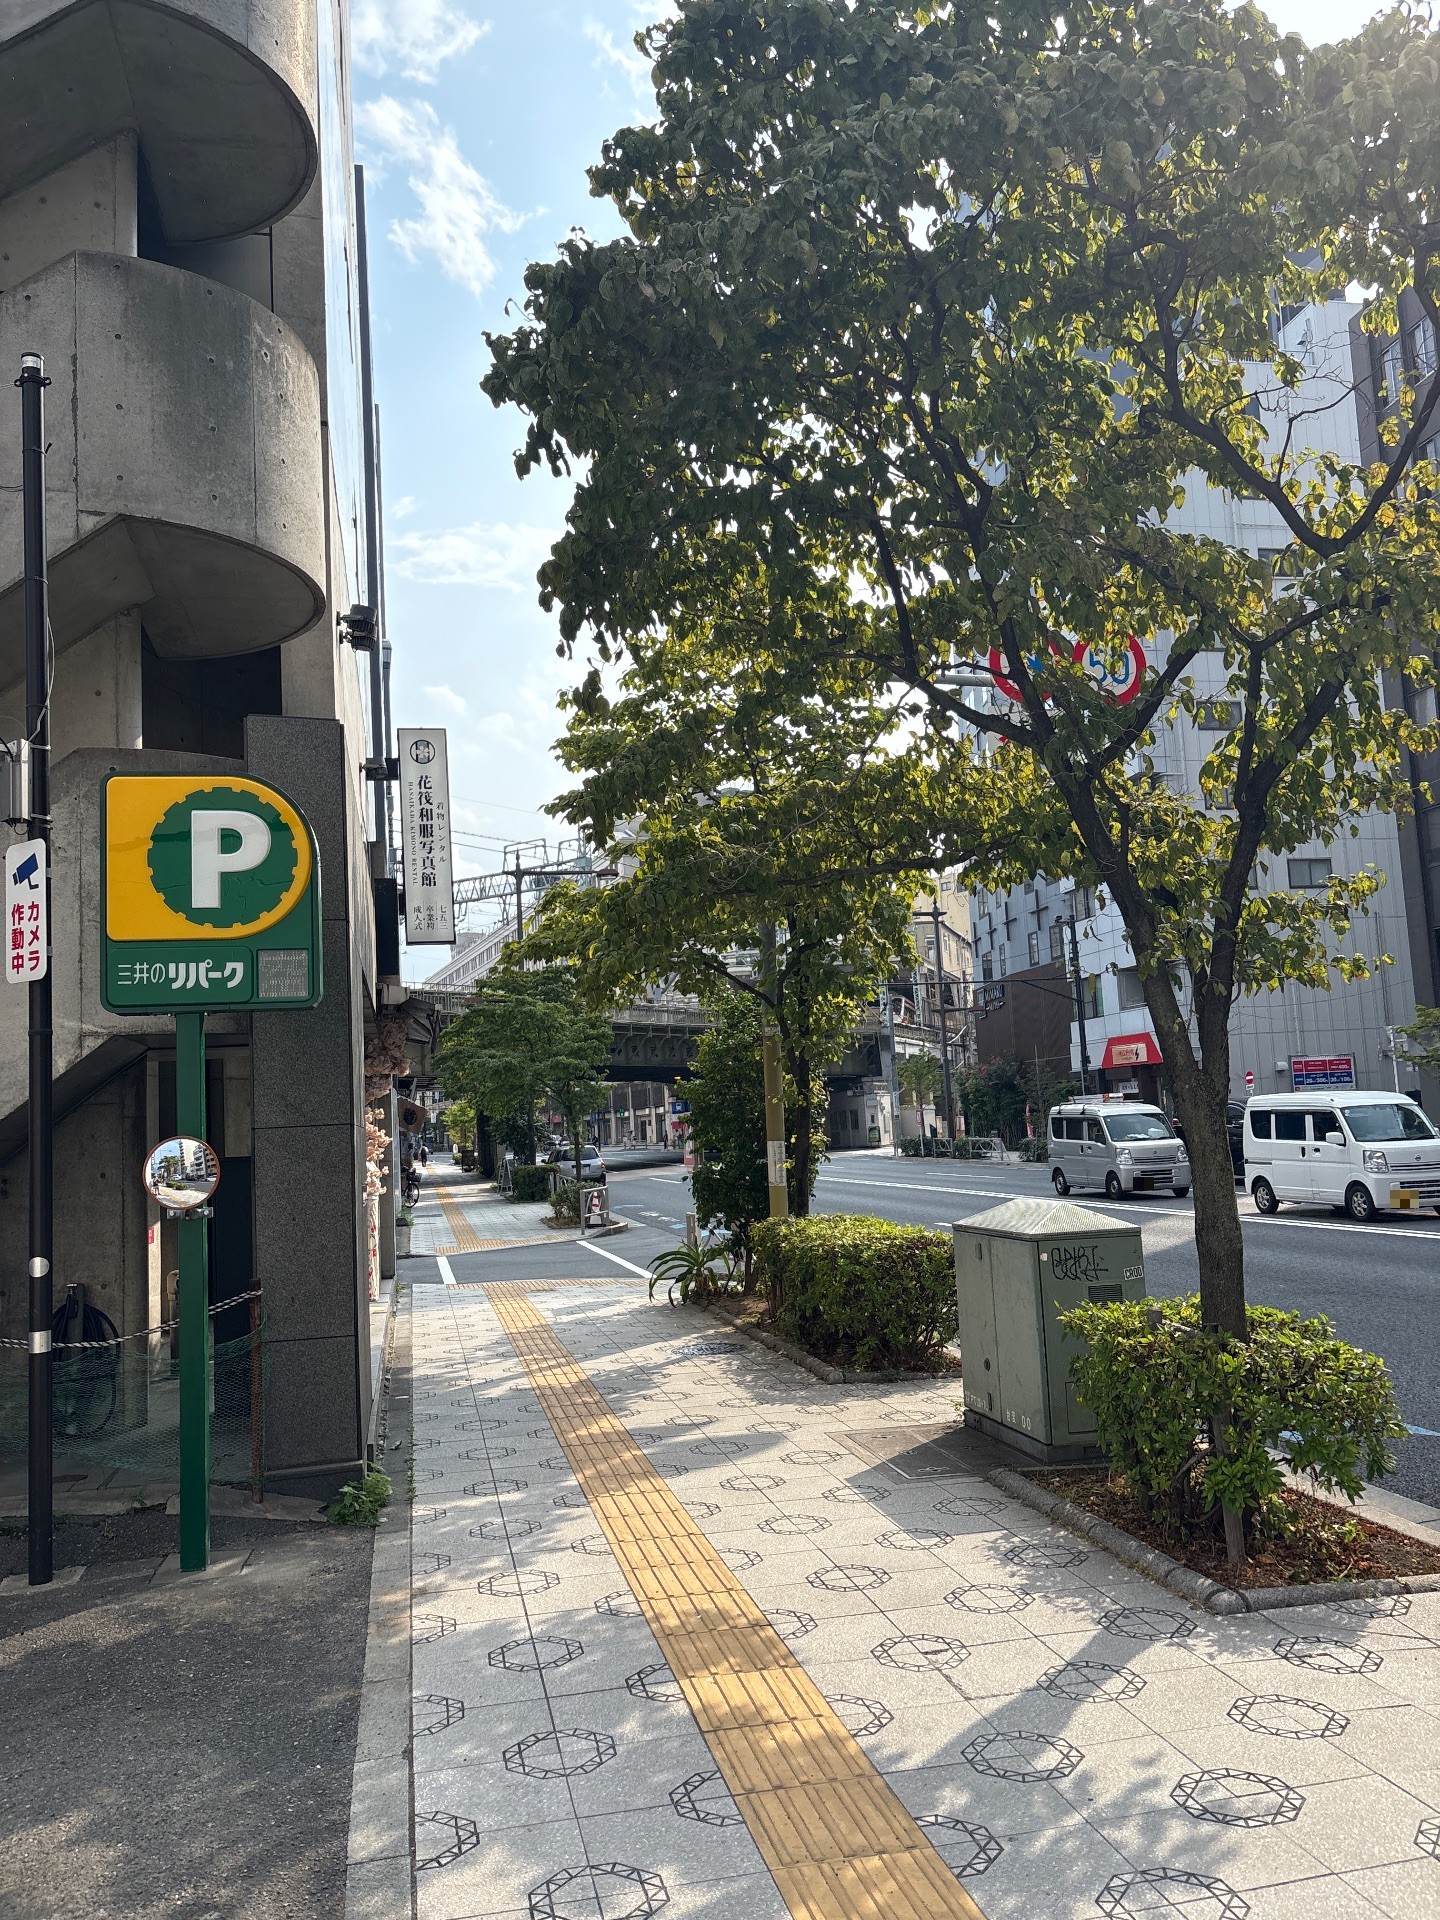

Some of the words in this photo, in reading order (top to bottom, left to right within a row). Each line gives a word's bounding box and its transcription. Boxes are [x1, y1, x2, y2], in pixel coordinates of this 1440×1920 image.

[1089, 648, 1130, 685] 50
[410, 826, 418, 856] KIMONO
[417, 774, 437, 888] 花筏和服写真館
[435, 801, 448, 863] 着物レンタル
[191, 809, 272, 909] P
[411, 858, 419, 886] RENTAL
[413, 905, 423, 931] 成人式
[439, 904, 449, 930] 七五三
[11, 902, 25, 975] 作動中
[27, 900, 41, 972] カメラ
[117, 958, 244, 990] 三井のリパーク
